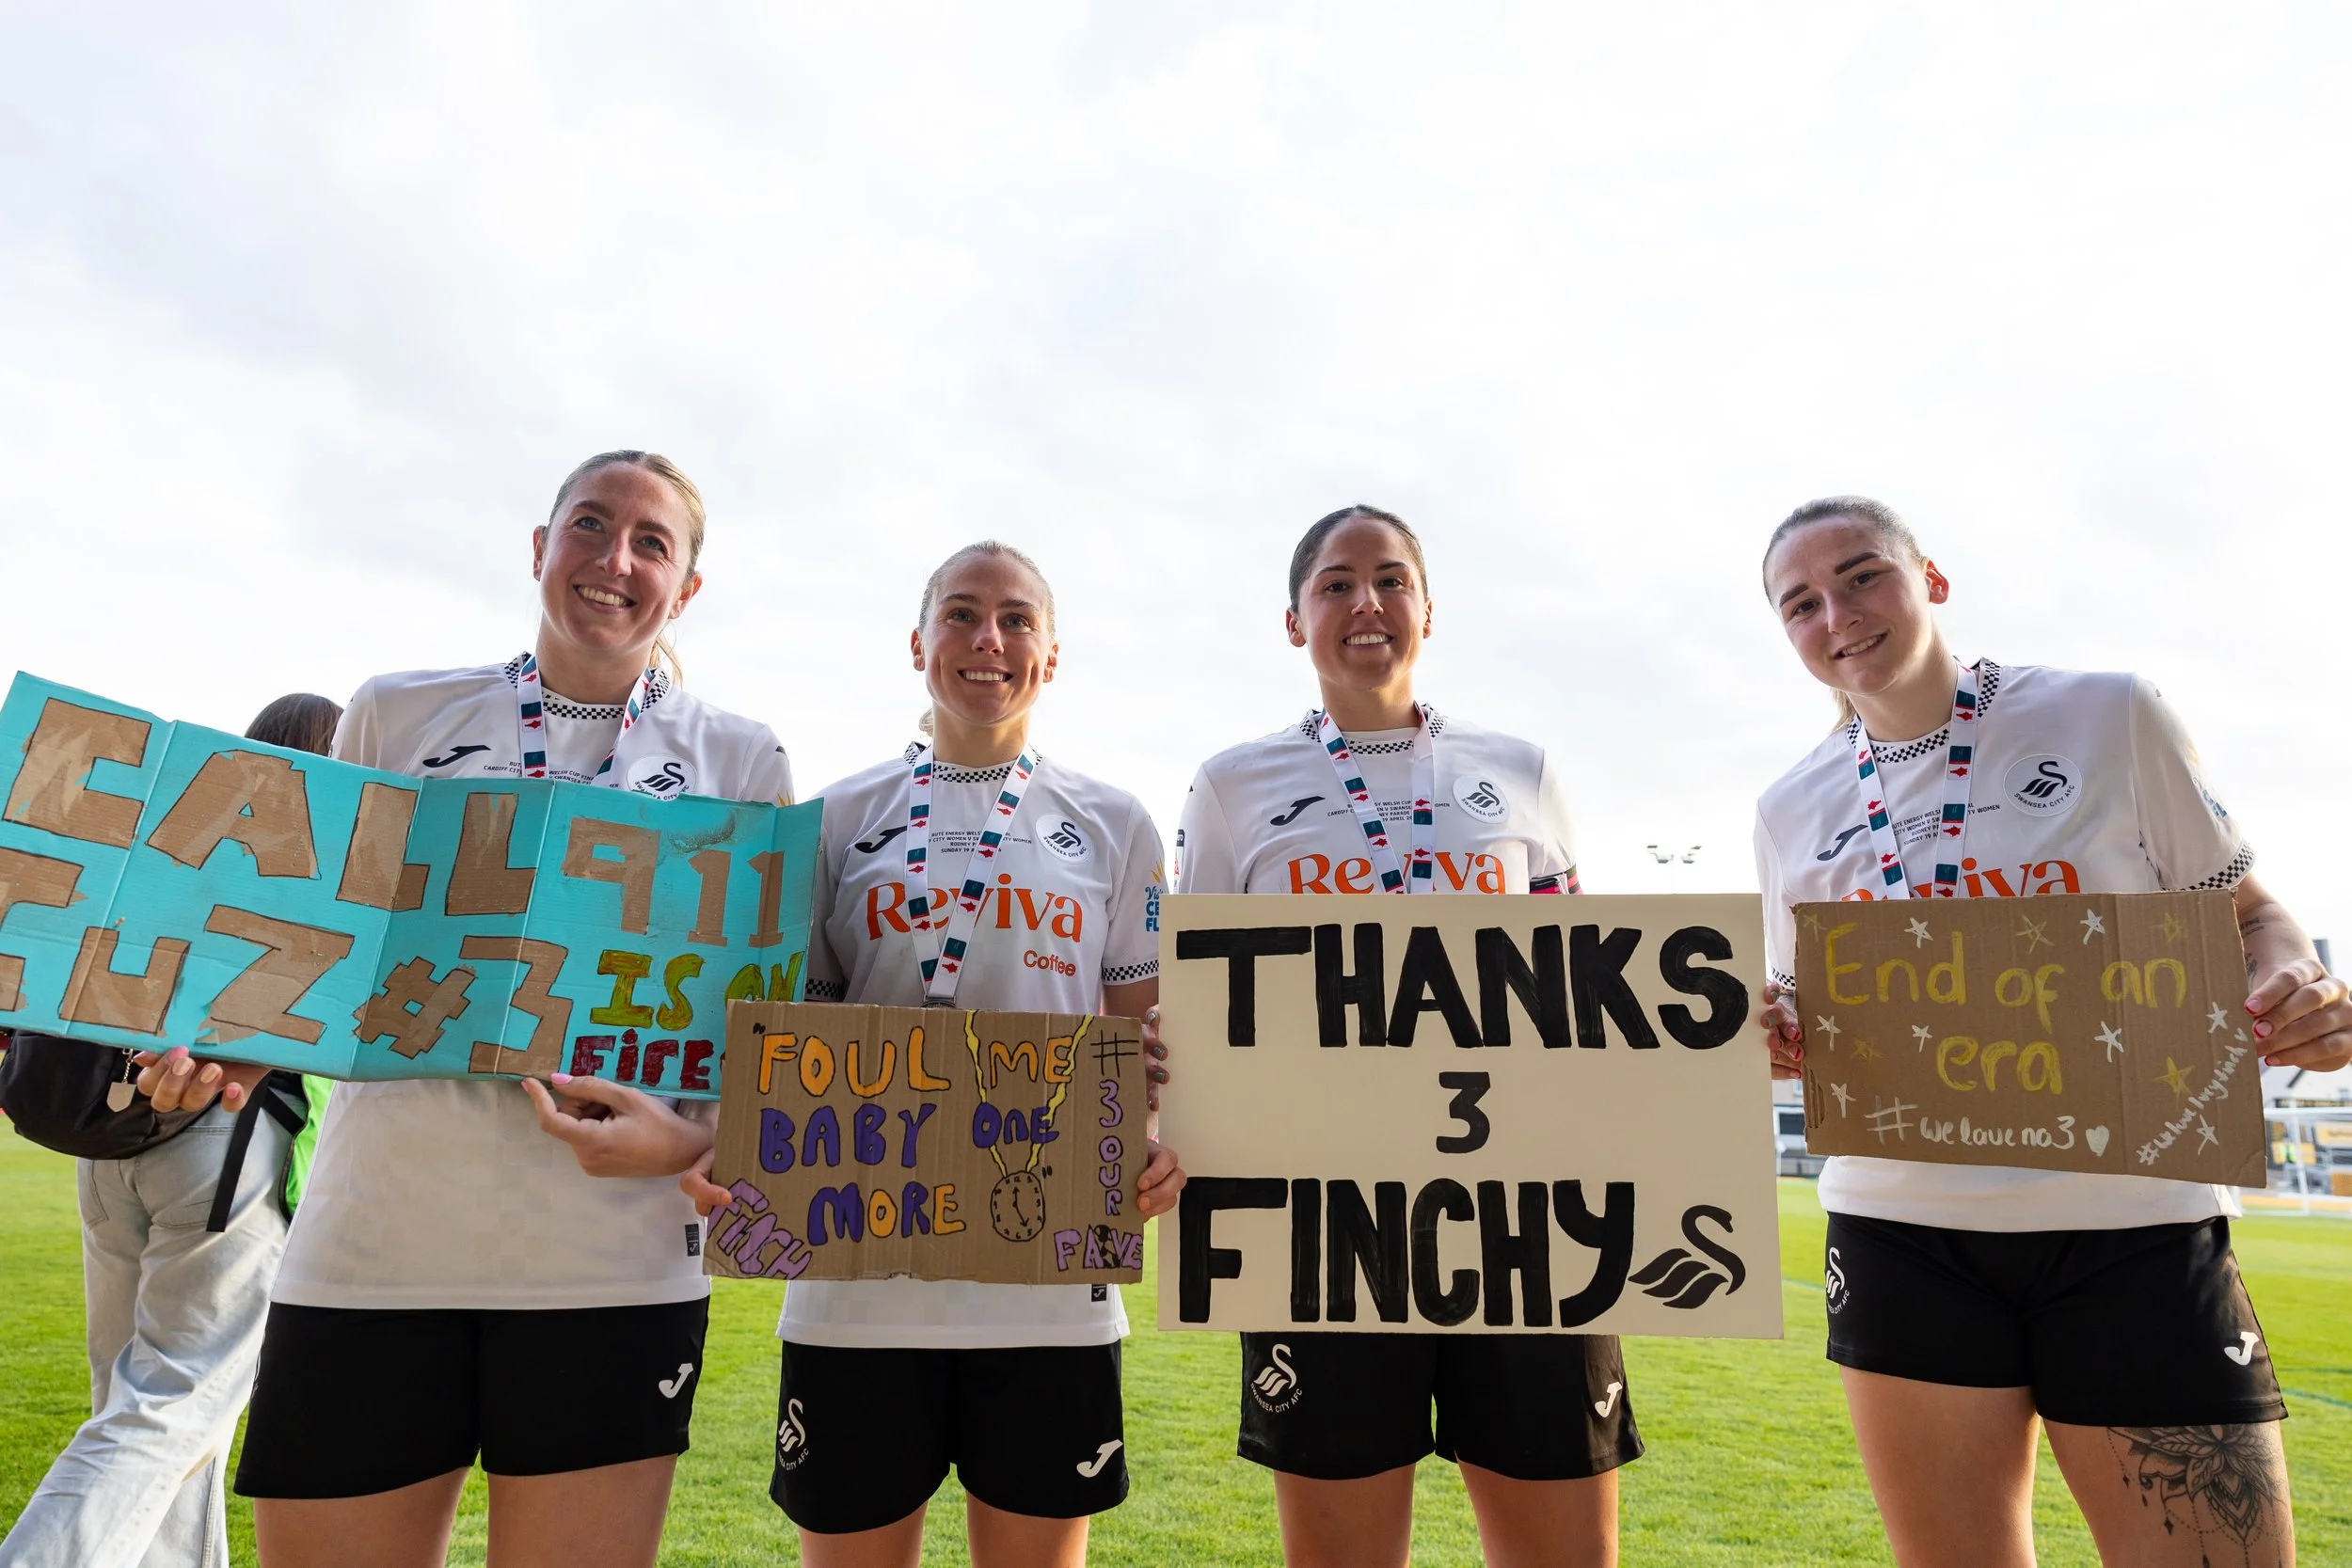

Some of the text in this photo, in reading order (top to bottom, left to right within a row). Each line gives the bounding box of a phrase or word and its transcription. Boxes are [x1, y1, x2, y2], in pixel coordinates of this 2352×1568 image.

[2, 696, 786, 947] CALL 911
[1978, 804, 2000, 813] WOMEN
[2013, 784, 2075, 809] SWANSEA CITY AFC
[590, 949, 706, 1030] IS
[1023, 949, 1077, 977] Coffee
[1176, 922, 1750, 1050] THANKS
[1824, 922, 2187, 1035] End of an
[989, 1035, 1074, 1090] ME
[1936, 1035, 2063, 1096] era
[759, 1102, 937, 1174] BABY
[1436, 1071, 1491, 1154] 3
[806, 1180, 967, 1247] MORE
[1179, 1177, 1635, 1328] FINCHY
[1250, 1383, 1303, 1413] SWANSEA CITY AFC
[798, 1448, 809, 1465] AFC
